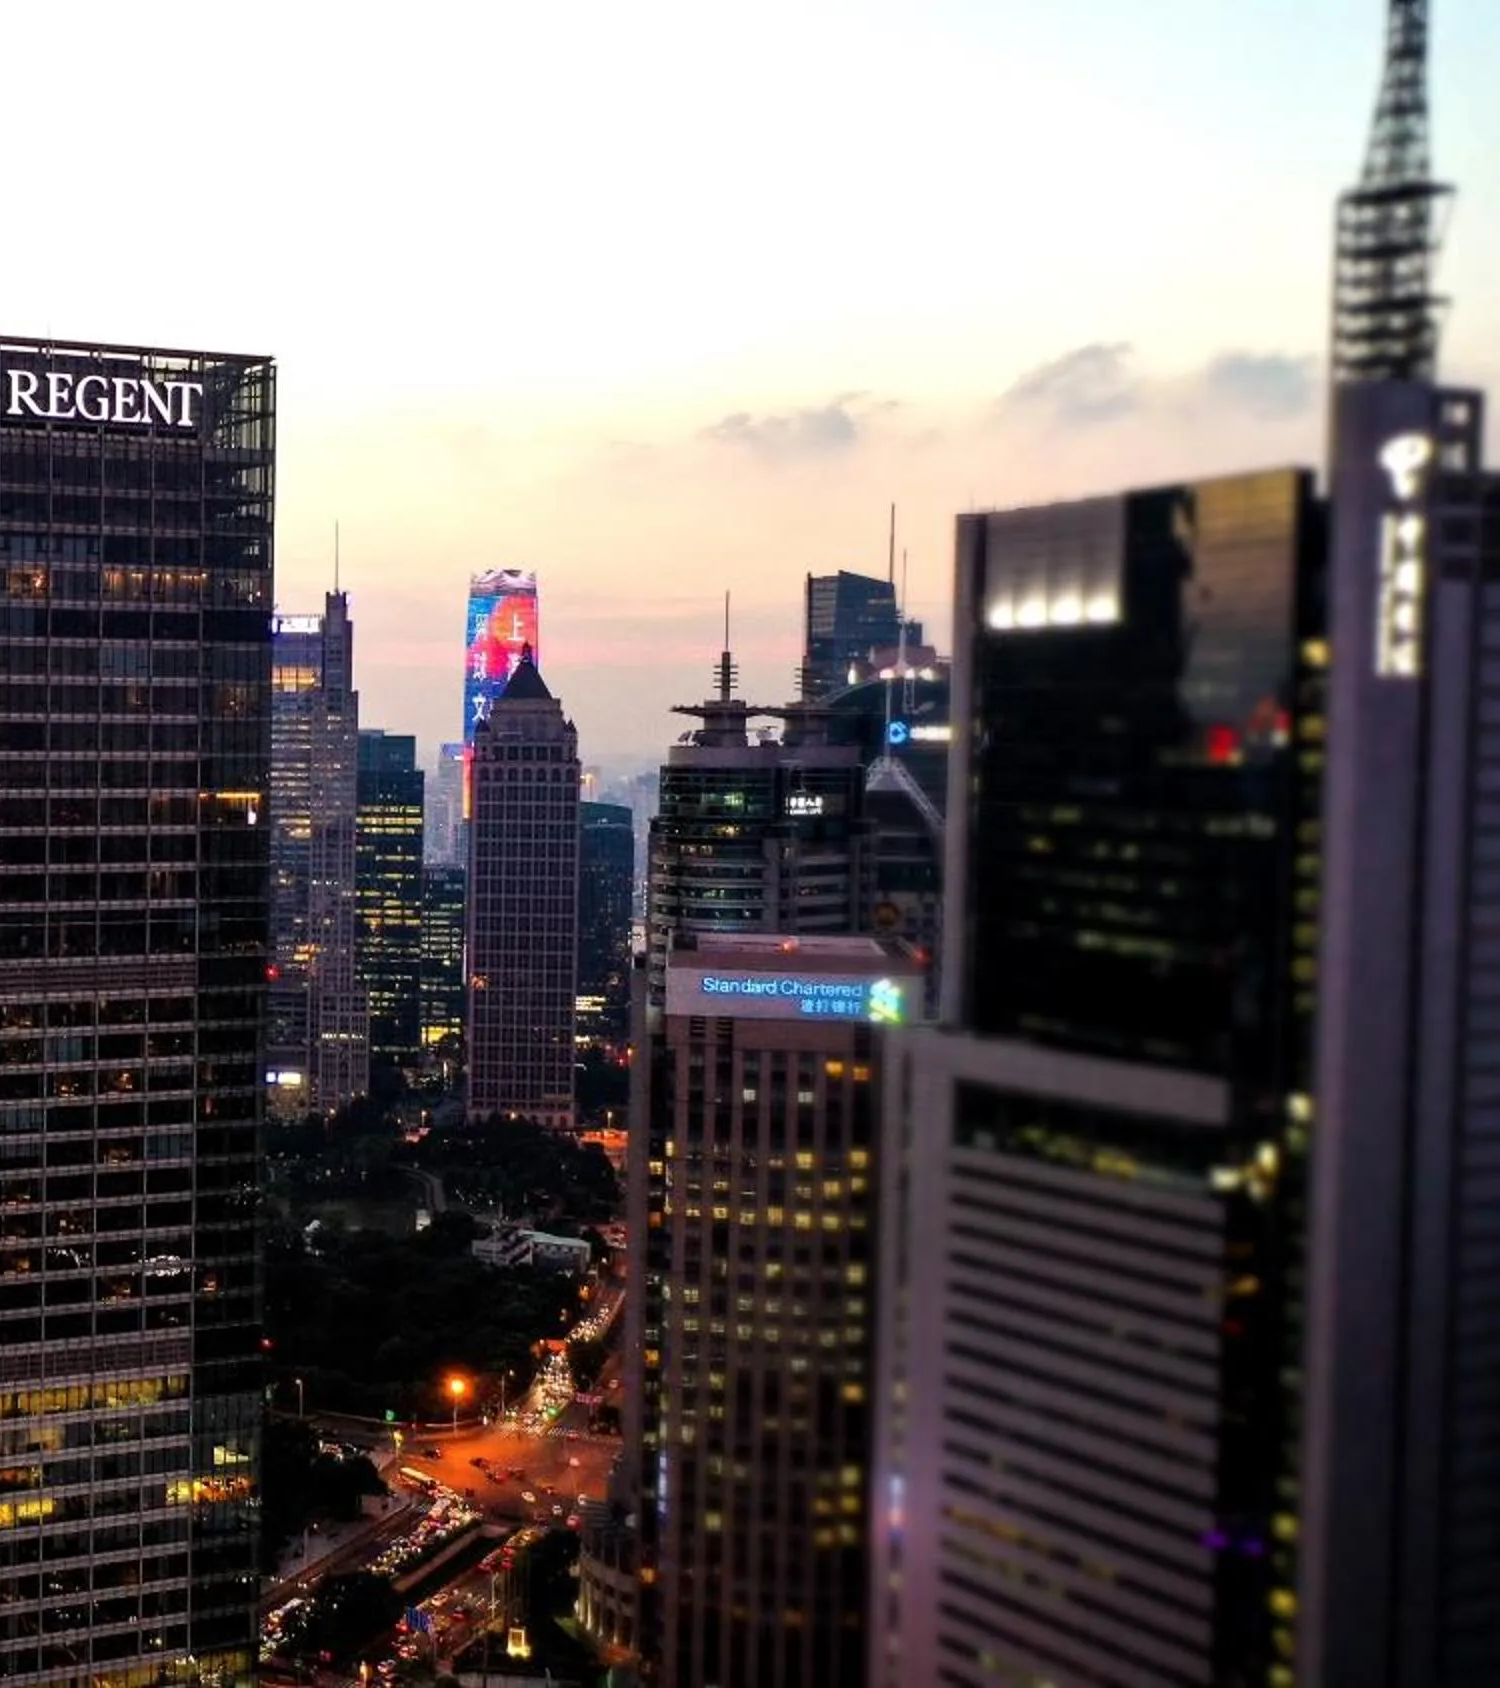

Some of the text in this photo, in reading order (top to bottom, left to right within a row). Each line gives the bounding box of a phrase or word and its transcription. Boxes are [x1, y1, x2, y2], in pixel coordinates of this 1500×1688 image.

[6, 369, 203, 427] REGENT
[703, 976, 862, 998] Standard Chartered
